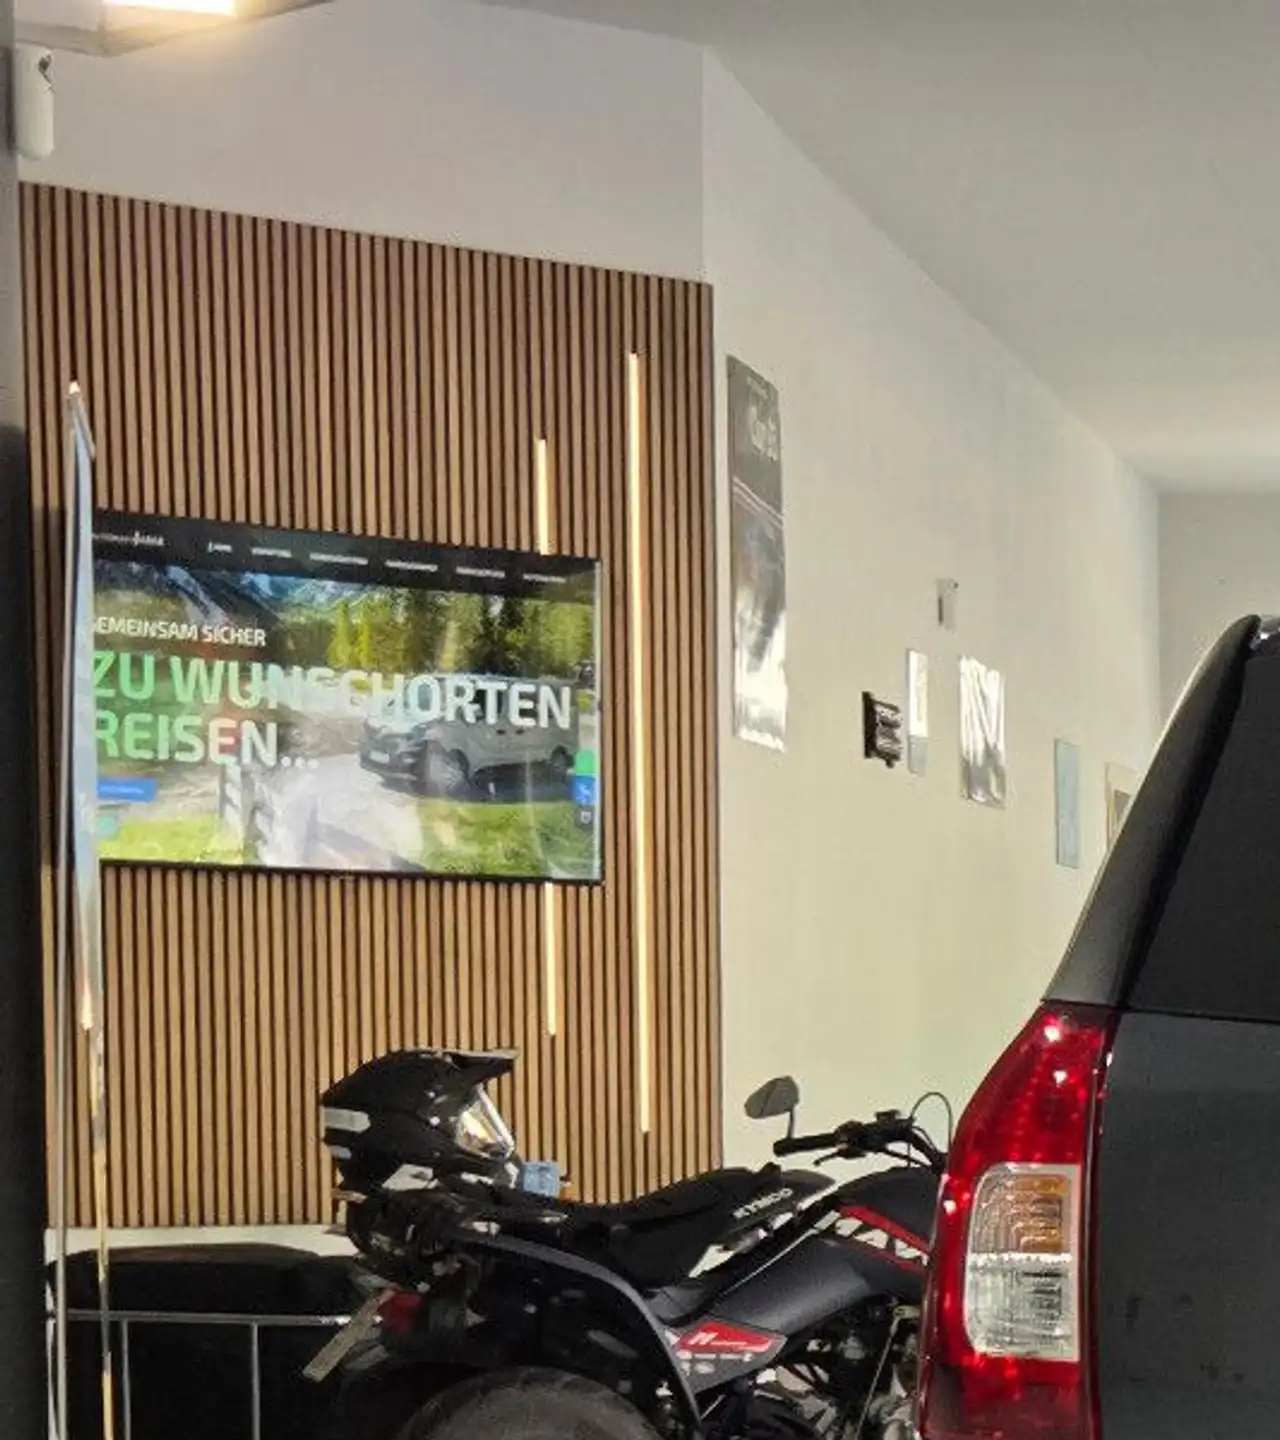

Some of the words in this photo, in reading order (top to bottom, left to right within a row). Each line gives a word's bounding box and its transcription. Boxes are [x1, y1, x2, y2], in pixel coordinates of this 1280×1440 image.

[200, 625, 267, 647] SICHER
[93, 651, 155, 700] ZU
[169, 655, 573, 730] WUNSCHORTEN
